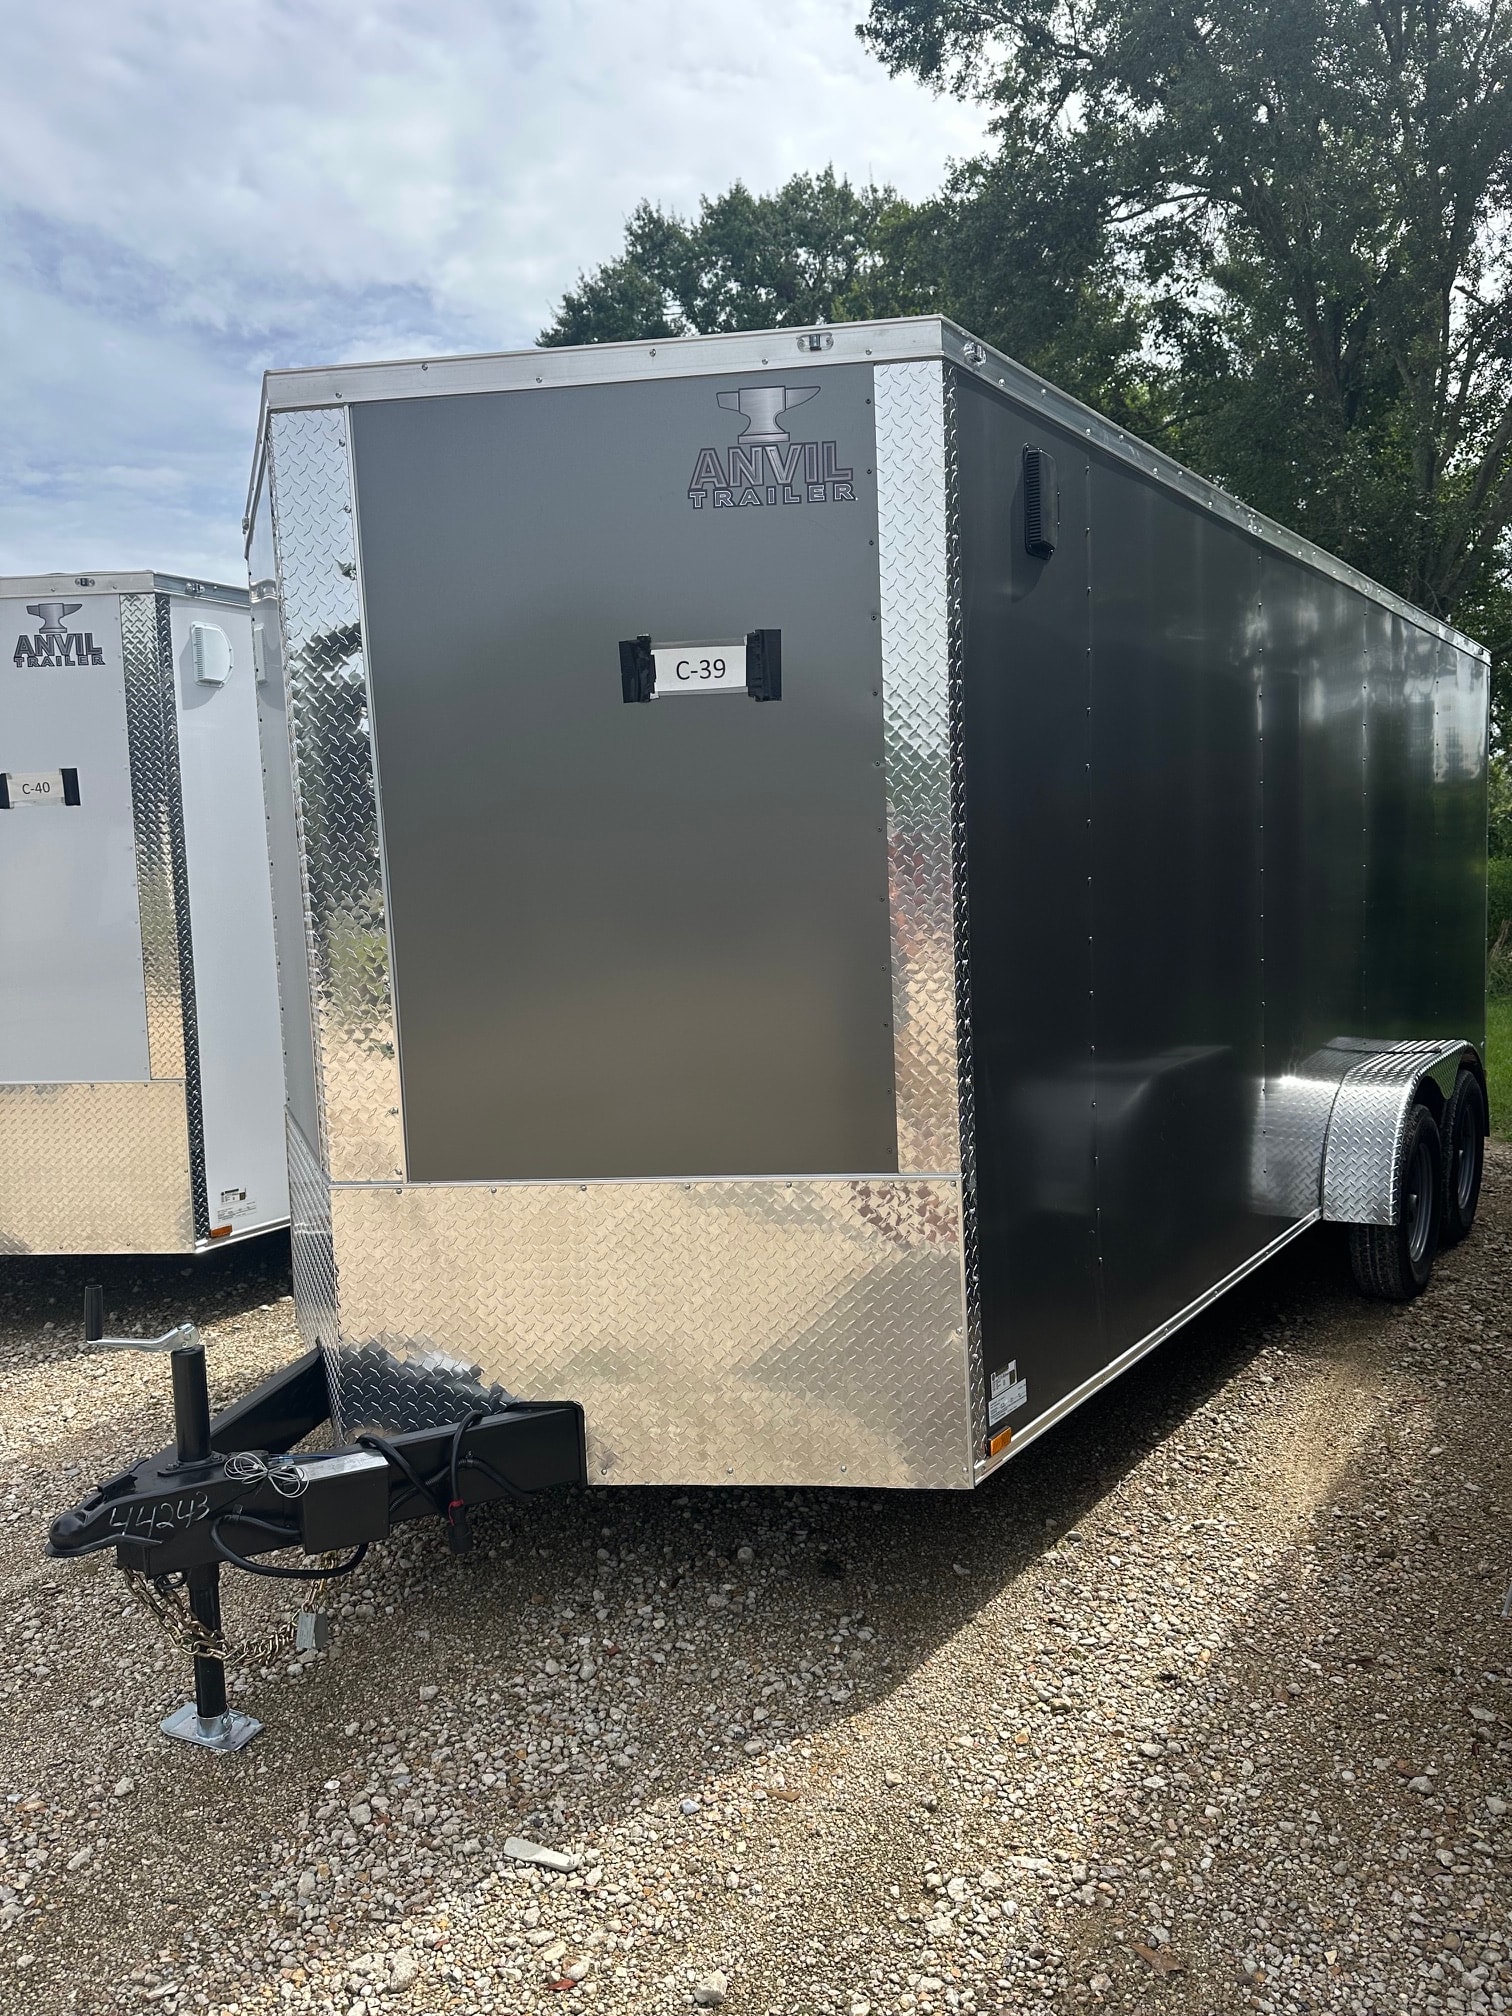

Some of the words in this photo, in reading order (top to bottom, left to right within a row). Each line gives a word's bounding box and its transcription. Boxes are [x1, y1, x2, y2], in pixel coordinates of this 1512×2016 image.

[689, 441, 853, 490] ANVIL
[688, 482, 858, 509] TRAILER
[14, 633, 102, 657] ANVIL
[14, 654, 106, 667] TRAILER
[676, 658, 726, 680] C-39
[22, 782, 50, 794] C-40
[109, 1491, 210, 1537] 44243
